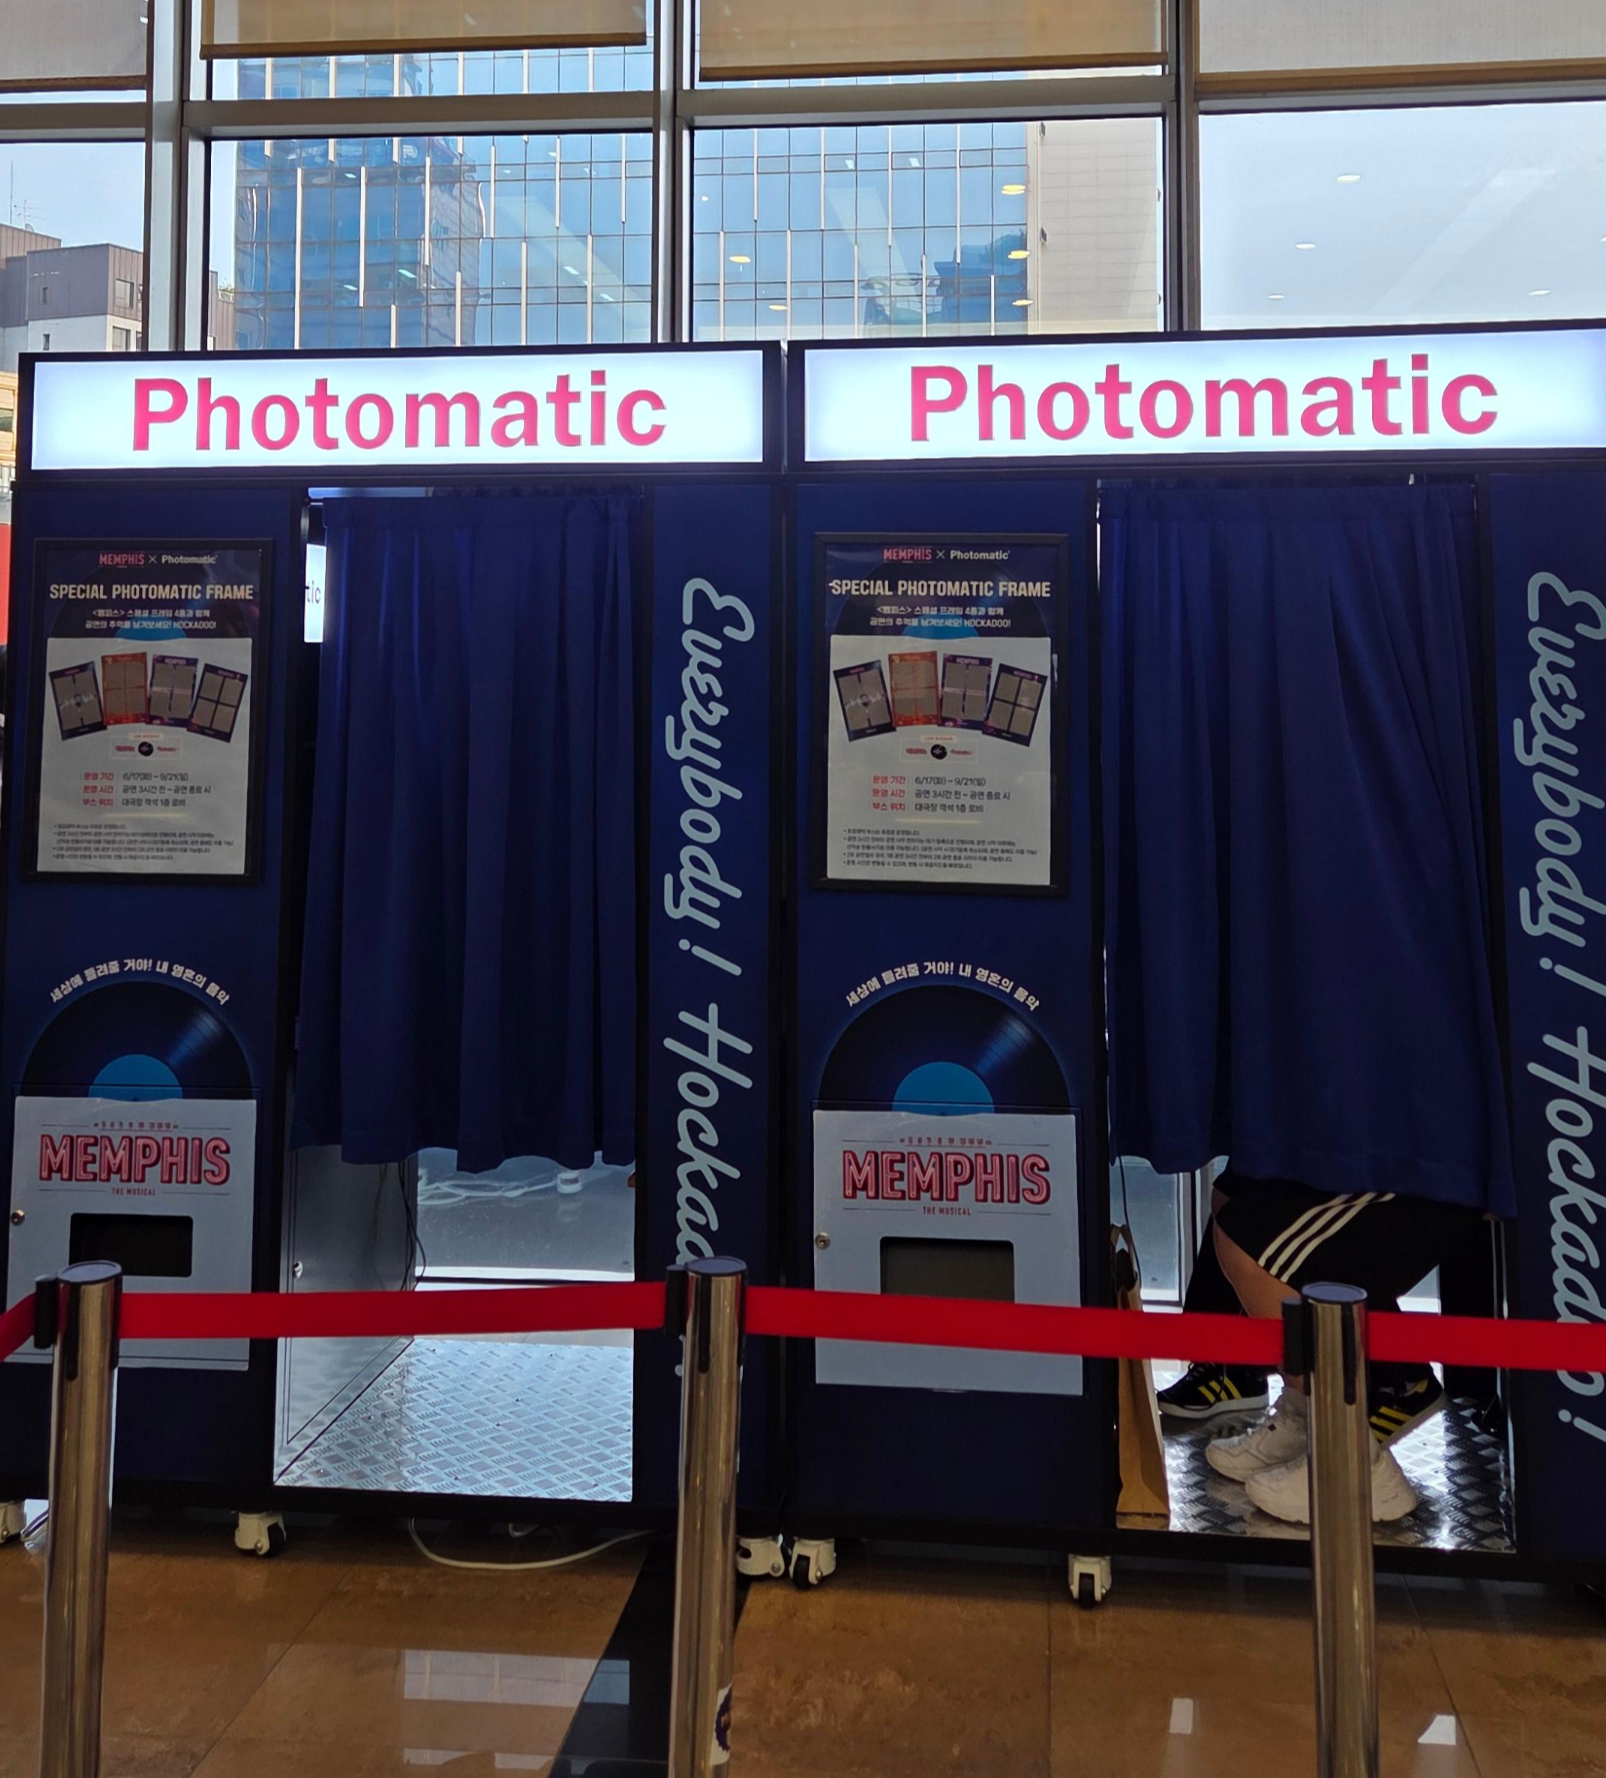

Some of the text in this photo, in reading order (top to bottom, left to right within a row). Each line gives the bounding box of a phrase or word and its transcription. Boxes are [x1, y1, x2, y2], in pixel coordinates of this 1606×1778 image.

[910, 354, 1498, 442] Photomatic
[133, 370, 666, 451] Photomatic
[99, 553, 145, 565] MEMPHIS
[883, 548, 932, 560] MEMPHIS
[950, 549, 1010, 560] Photomatic
[49, 584, 254, 600] SPECIAL PHOTOMATIC FRAME
[831, 579, 1051, 597] SPECIAL PHOTOMATIC FRAME
[100, 772, 115, 781] 기간
[872, 775, 888, 785] 운영
[890, 775, 906, 785] 기간
[915, 776, 946, 786] 6/17(화)
[954, 777, 986, 787] 9/21(일)
[99, 785, 114, 795] 시간
[122, 785, 137, 795] 공연
[137, 785, 157, 795] 3시간
[173, 785, 187, 795] 공연
[204, 785, 211, 795] 시
[872, 789, 888, 798] 운영
[890, 789, 905, 798] 시간
[915, 789, 930, 799] 공연
[931, 790, 952, 800] 3시간
[953, 790, 962, 800] 전
[969, 791, 985, 800] 공연
[986, 791, 1001, 801] 종료
[1002, 791, 1011, 801] 시
[872, 802, 984, 813] 부스 위치 대극장 객석 1층 로비
[50, 958, 230, 1006] 세상에 들려줄 거야! 내 영혼의 음악
[845, 961, 1040, 1012] 세상에 들려줄 거야! 내 영혼의 음악
[39, 1133, 231, 1186] MEMPHIS
[842, 1148, 1051, 1206] MEMPHIS
[112, 1187, 156, 1196] THE MUSICAL
[923, 1206, 971, 1216] THE MUSICAL
